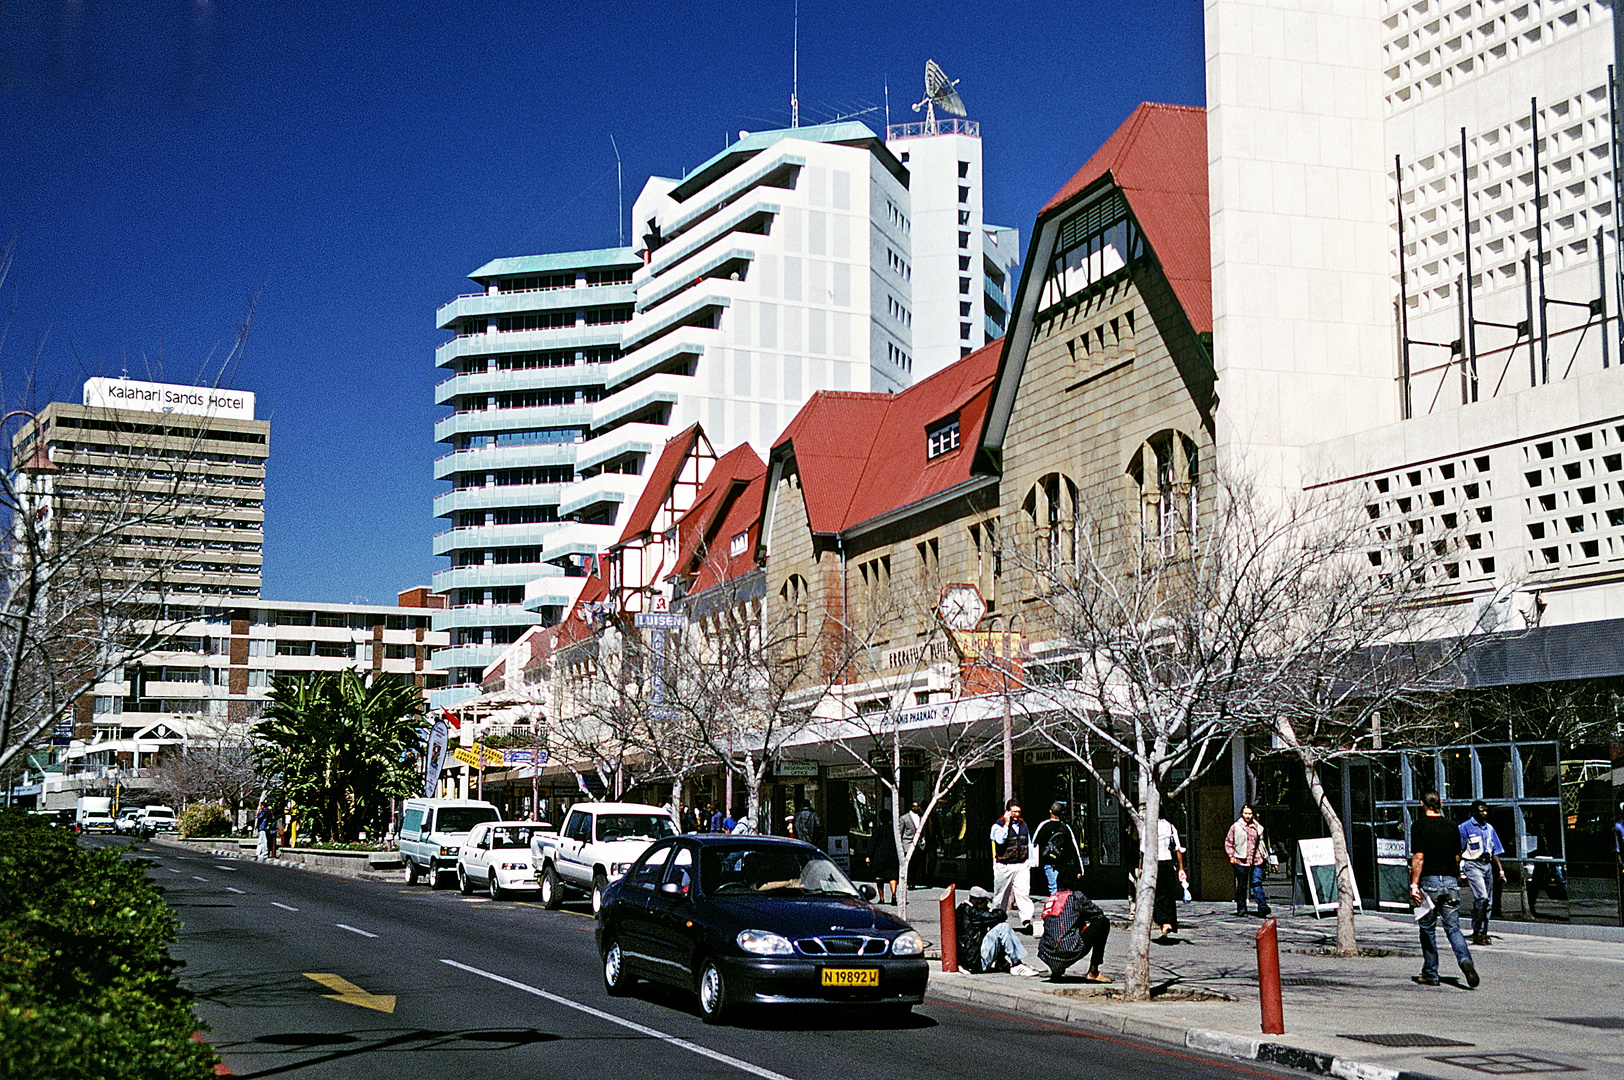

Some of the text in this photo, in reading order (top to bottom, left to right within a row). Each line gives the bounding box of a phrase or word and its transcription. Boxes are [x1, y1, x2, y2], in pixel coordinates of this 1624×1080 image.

[108, 385, 244, 409] Kalahari Sands Hotel
[638, 615, 682, 626] LUISEN
[909, 709, 938, 723] PHARMACY
[835, 971, 867, 983] 19892
